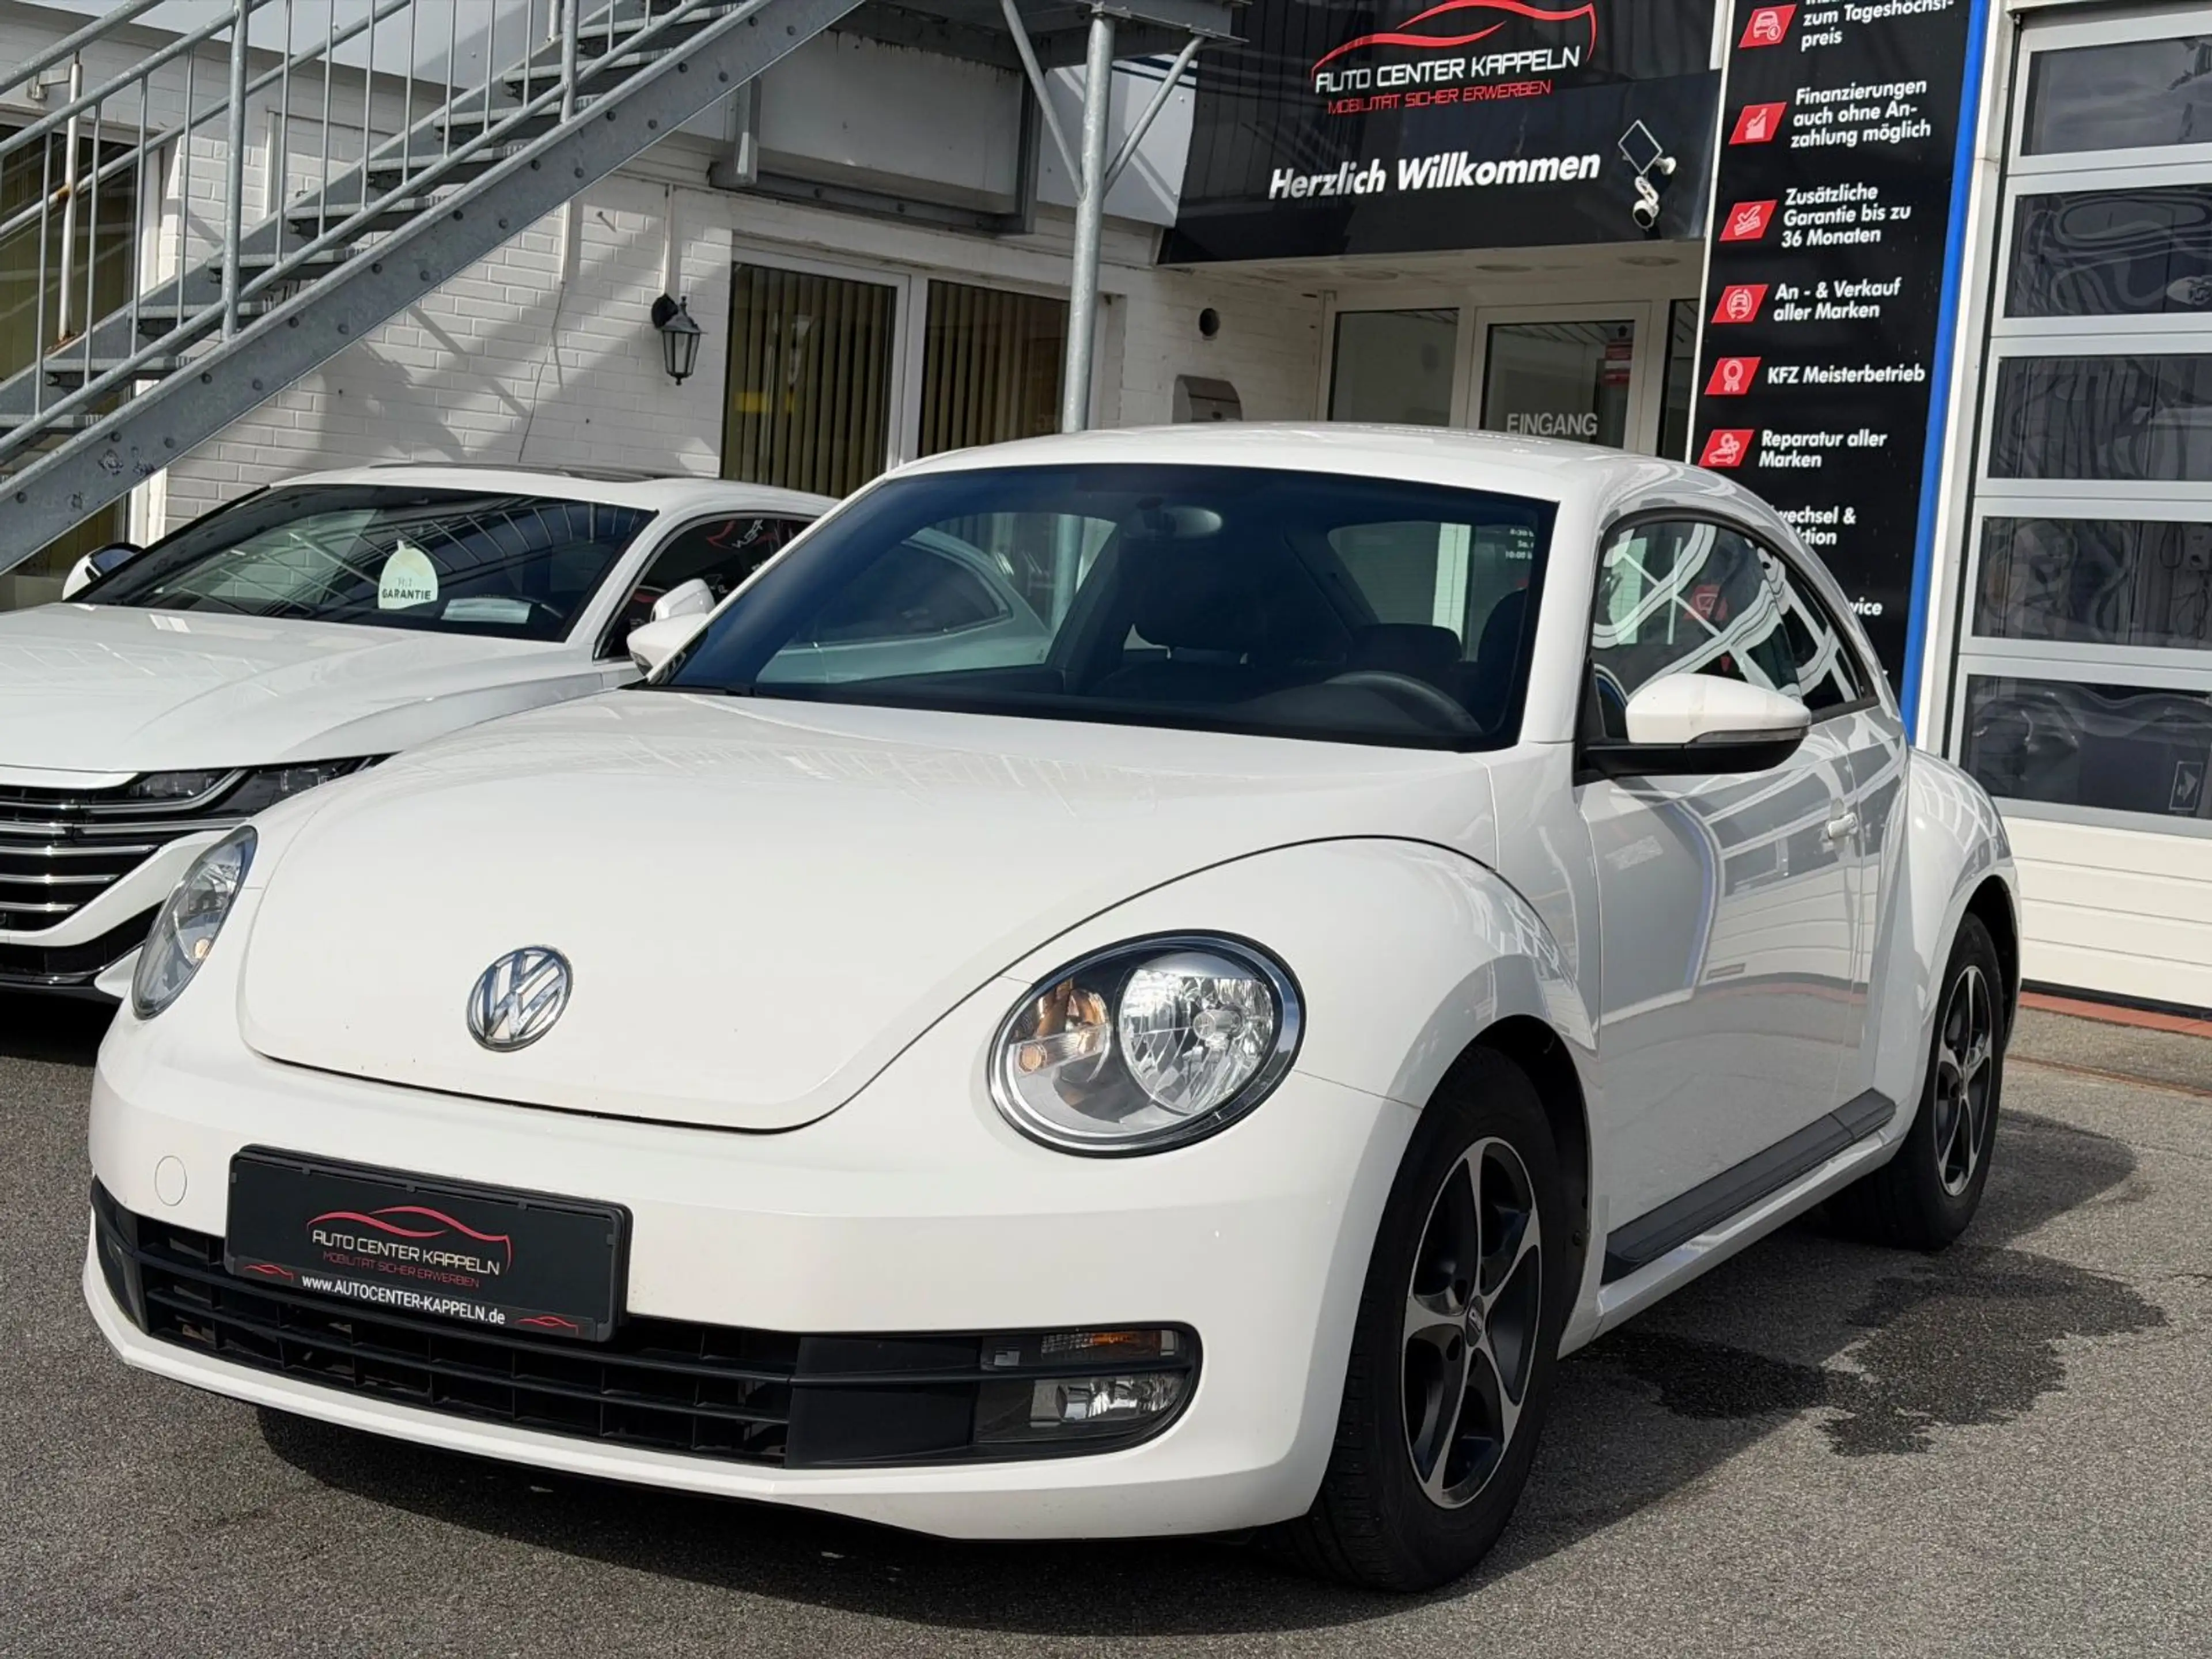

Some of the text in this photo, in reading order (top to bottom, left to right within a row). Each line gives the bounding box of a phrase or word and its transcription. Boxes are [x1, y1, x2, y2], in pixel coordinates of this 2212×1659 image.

[1803, 10, 1838, 26] zum
[1801, 26, 1842, 52] preis
[1316, 46, 1580, 93] AUTO CENTER KAPPELN
[1404, 88, 1459, 107] SICHER
[1463, 79, 1551, 101] ERWERBEN
[1796, 80, 1927, 106] Finanzierungen
[1793, 101, 1918, 127] auch ohne An-
[1790, 120, 1931, 149] zahlung möglich
[1268, 151, 1600, 199] Herzlich Willkommen
[1785, 183, 1878, 206] Zusätzliche
[1783, 203, 1911, 226] Garantie bis zu
[1781, 228, 1881, 248] 36 Monaten
[1774, 285, 1799, 301] An
[1815, 282, 1828, 298] &
[1834, 276, 1903, 297] Verkauf
[1774, 302, 1880, 321] aller Marken
[1767, 363, 1926, 385] KFZ Meisterbetrieb
[1506, 412, 1597, 436] EINGANG
[1761, 429, 1888, 449] Reparatur aller
[1759, 450, 1822, 468] Marken
[1777, 505, 1856, 525] wechsel &
[382, 588, 431, 600] GARANTIE
[312, 1229, 500, 1275] AUTO CENTER KAPPELN
[378, 1260, 416, 1277] SICHER
[417, 1268, 479, 1288] ERWERBEN
[302, 1275, 506, 1325] www.AUTOCENTER-KAPPELN.de
